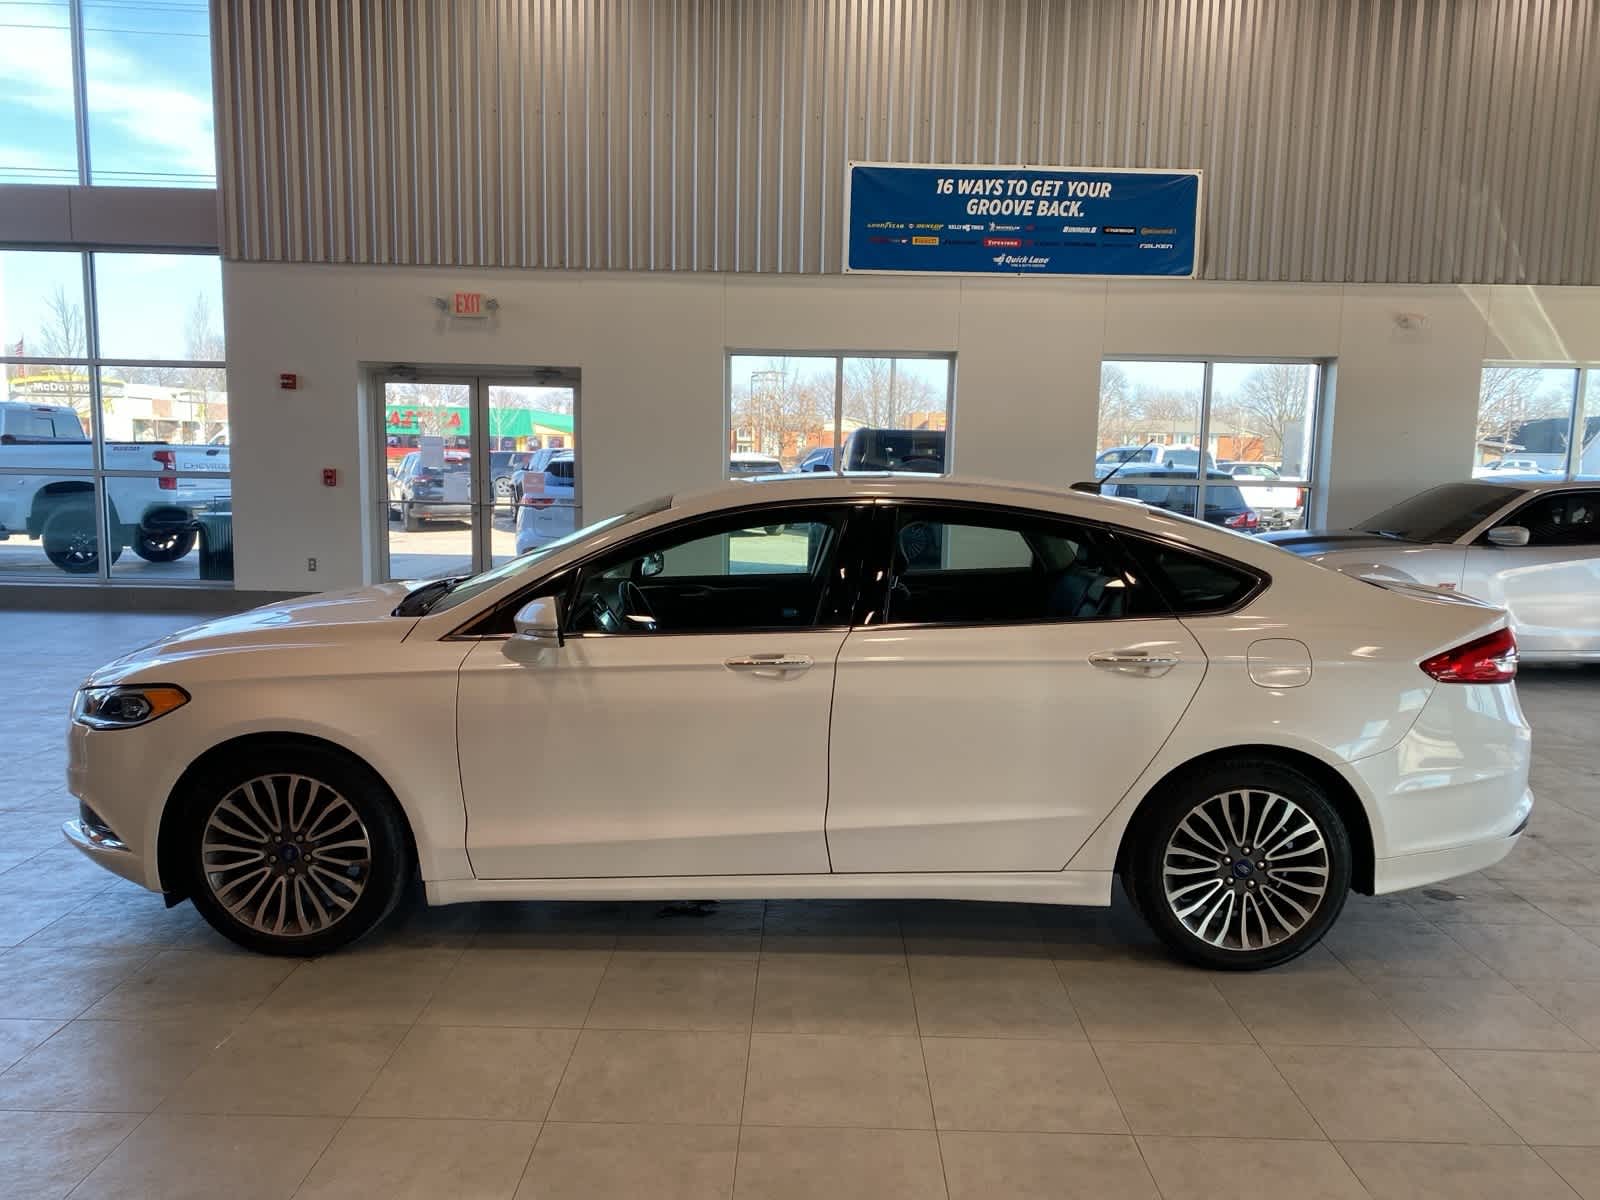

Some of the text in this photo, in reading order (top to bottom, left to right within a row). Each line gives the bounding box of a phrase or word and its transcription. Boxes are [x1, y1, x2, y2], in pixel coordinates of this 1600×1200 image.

[936, 178, 1112, 198] 16 WAYS TO GET YOUR
[966, 199, 1085, 217] GROOVE BACK.
[1005, 255, 1050, 264] Quick Lane
[455, 293, 481, 314] EXIT
